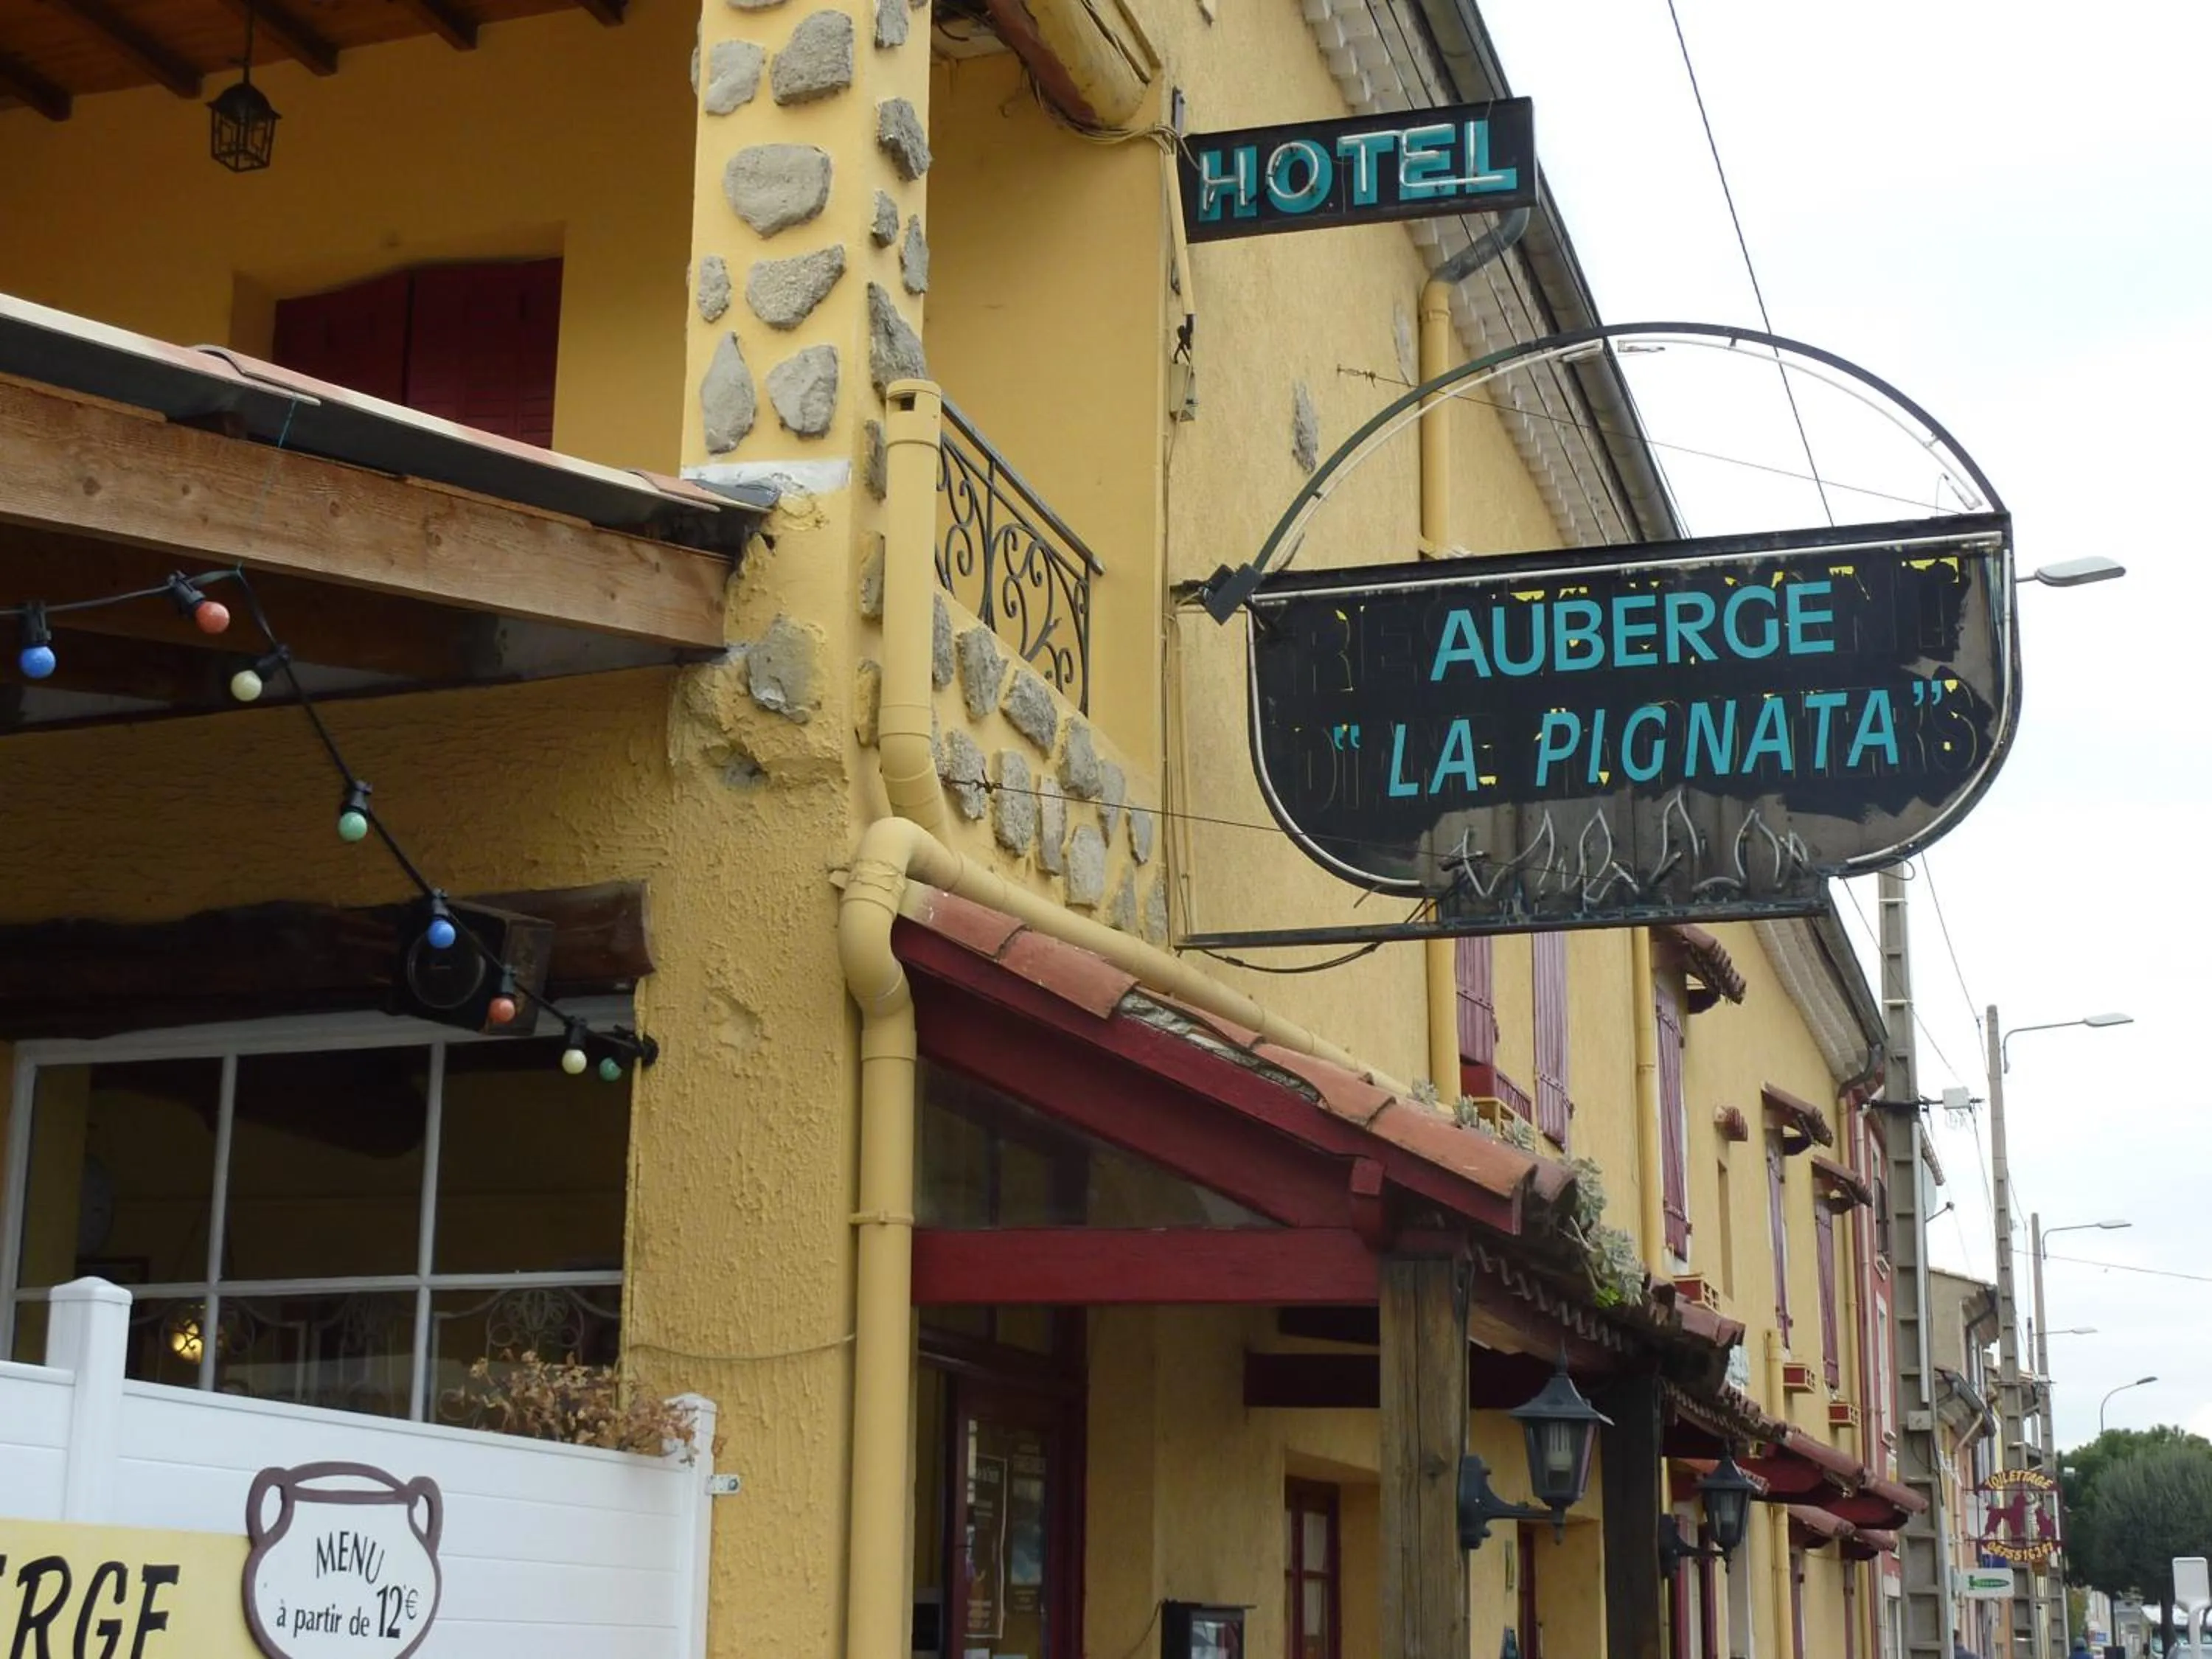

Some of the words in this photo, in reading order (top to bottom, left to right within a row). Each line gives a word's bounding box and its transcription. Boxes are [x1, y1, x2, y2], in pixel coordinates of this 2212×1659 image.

[1198, 119, 1517, 220] HOTEL
[1431, 580, 1835, 681] AUBERGE
[1985, 1470, 2053, 1489] TOILETTAGE
[316, 1531, 385, 1585] MENU
[0, 1554, 181, 1659] RGE
[276, 1599, 287, 1627] à
[293, 1604, 342, 1638] partir
[349, 1606, 369, 1637] de
